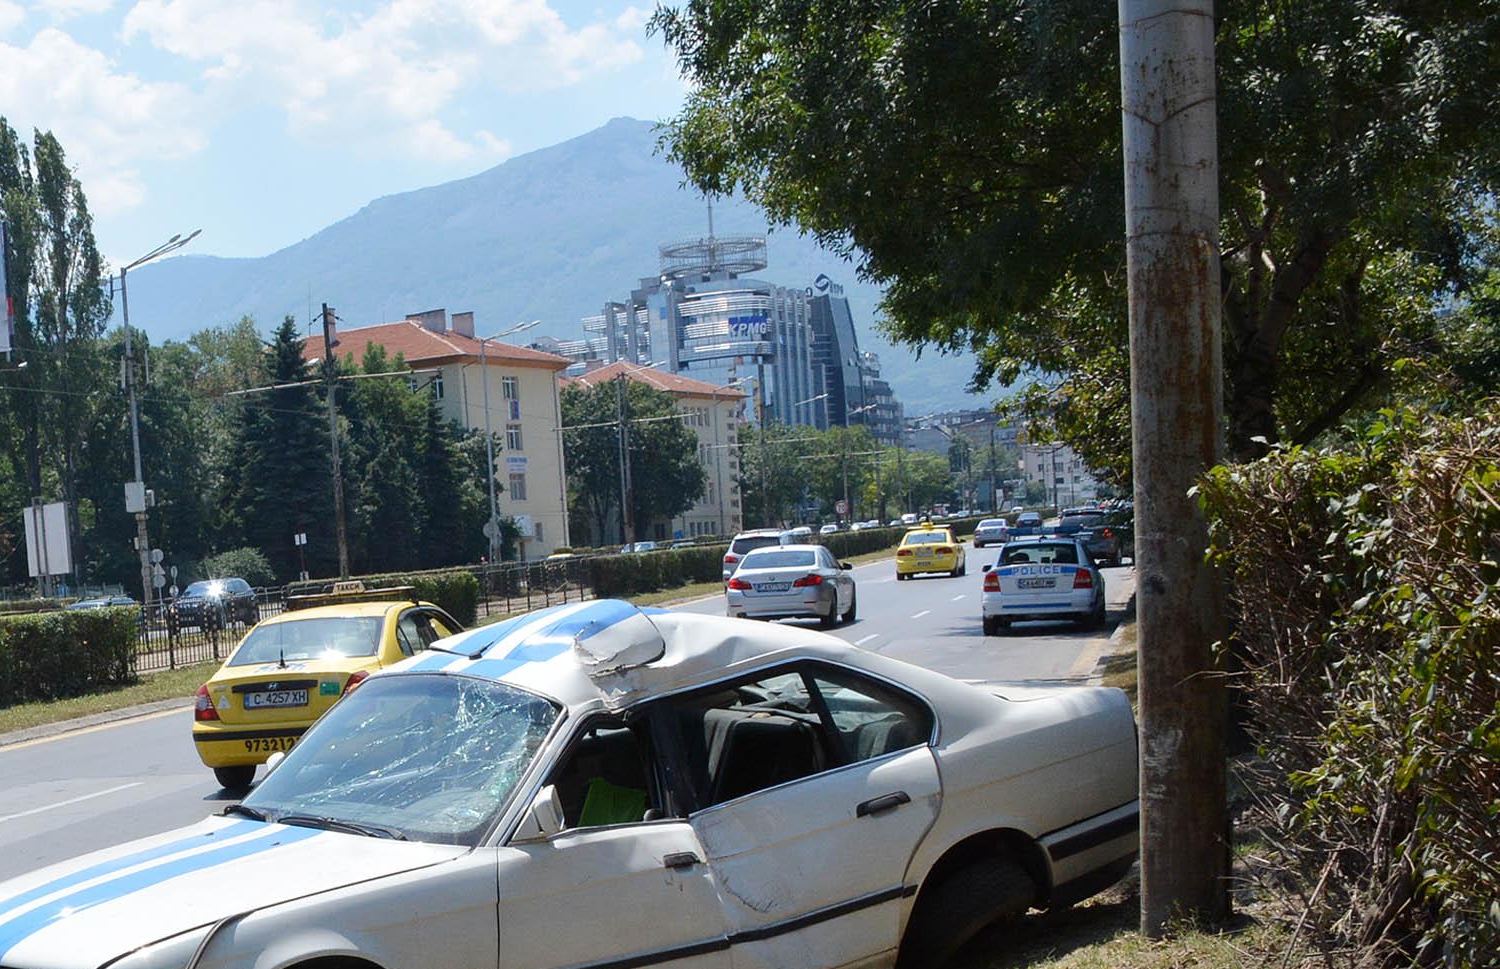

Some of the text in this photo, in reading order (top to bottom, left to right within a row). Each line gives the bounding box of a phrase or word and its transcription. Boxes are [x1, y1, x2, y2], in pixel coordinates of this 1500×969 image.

[729, 321, 767, 336] KPMG
[1012, 565, 1060, 576] POLICE
[244, 736, 301, 753] 973212
